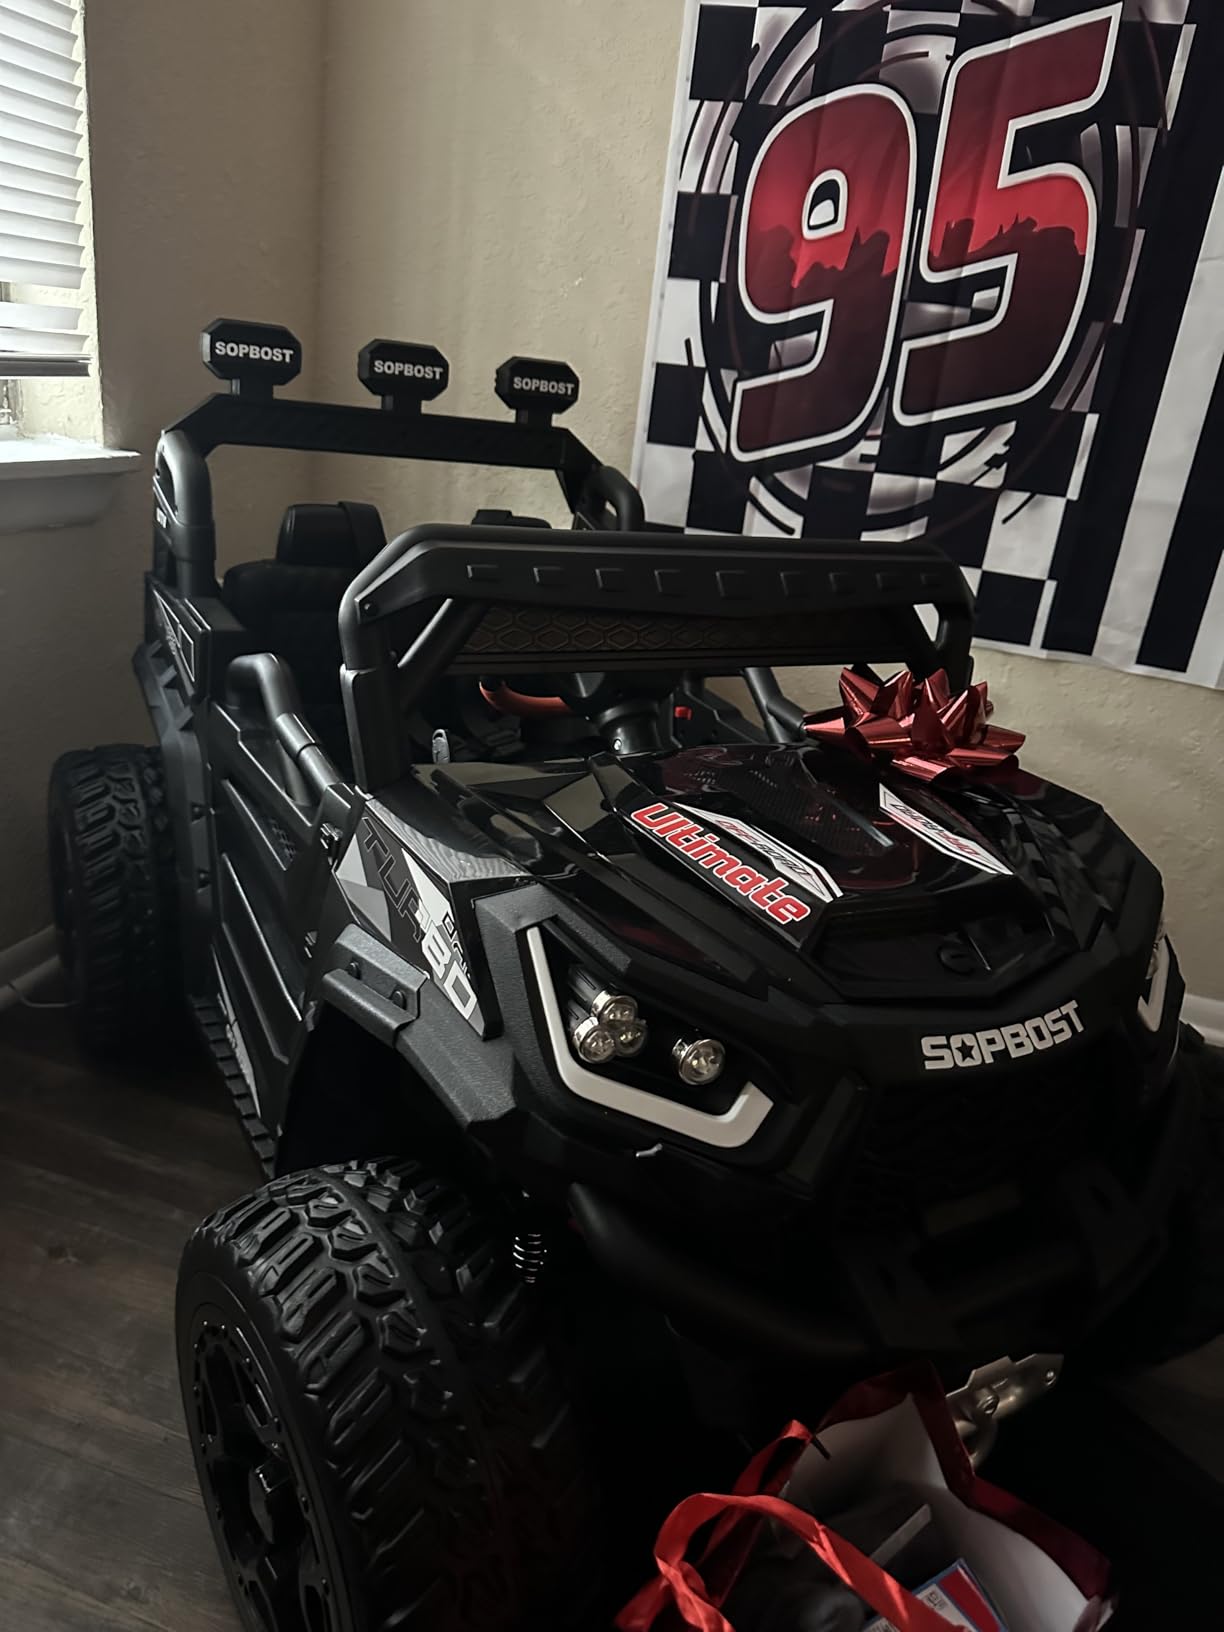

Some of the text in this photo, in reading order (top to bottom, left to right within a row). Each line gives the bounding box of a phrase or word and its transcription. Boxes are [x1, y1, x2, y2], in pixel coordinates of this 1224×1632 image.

[729, 2, 1123, 462] 95
[214, 340, 294, 364] SOPBOST
[373, 359, 444, 381] SOPBOST
[512, 375, 575, 396] SOPBOST
[630, 801, 812, 925] Ultimate
[920, 999, 1086, 1070] SOPBOST
